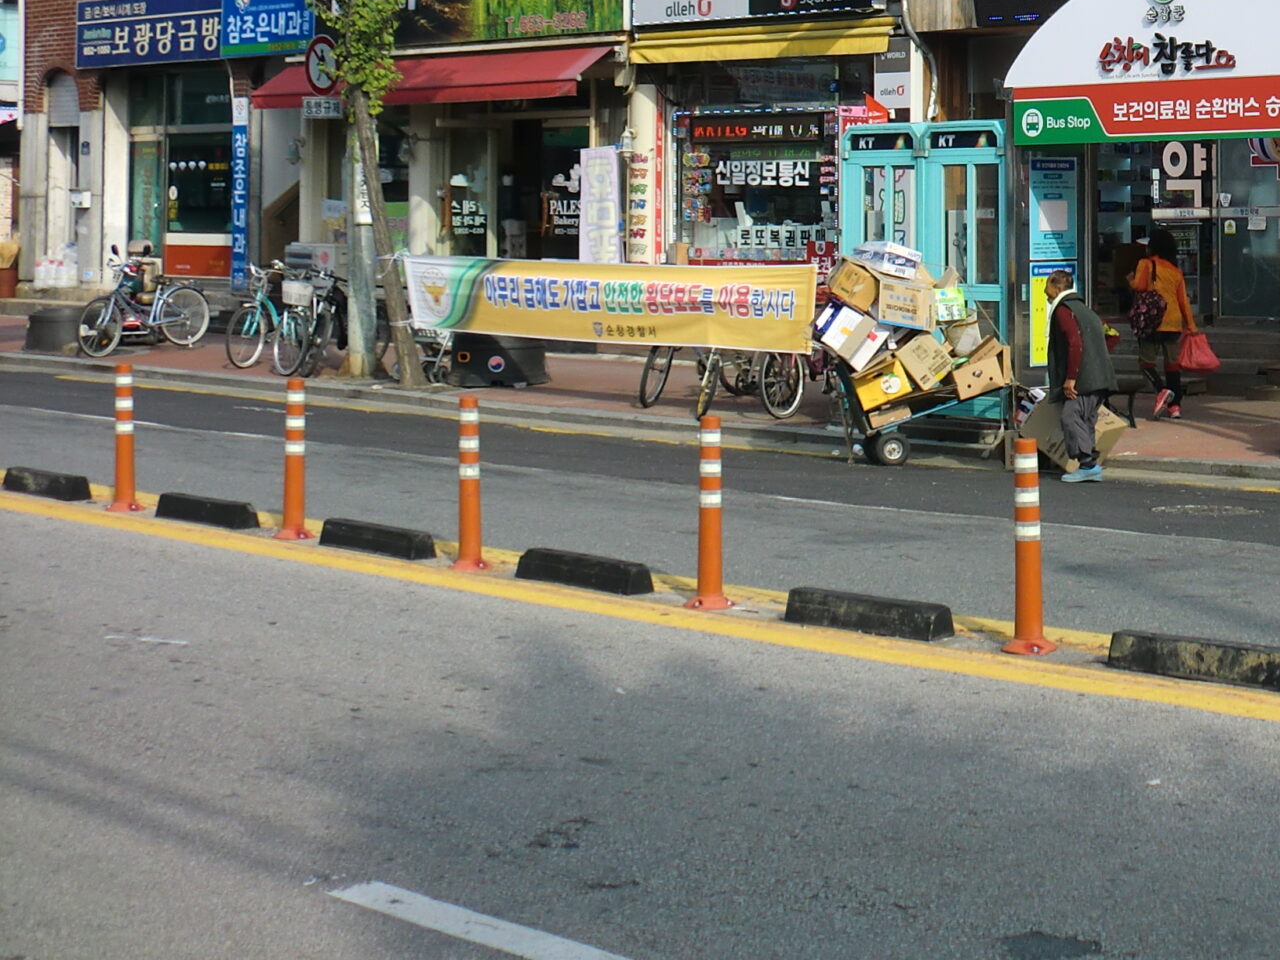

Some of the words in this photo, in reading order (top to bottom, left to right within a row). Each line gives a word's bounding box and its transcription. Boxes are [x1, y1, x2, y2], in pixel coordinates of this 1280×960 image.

[665, 0, 696, 18] olleh
[1144, 5, 1187, 23] 순창군
[227, 10, 302, 44] 참조은내과
[112, 17, 222, 56] 보광당금방
[887, 51, 906, 59] WORLD
[880, 87, 897, 96] olleh
[1112, 99, 1191, 122] 보건의료원
[1195, 97, 1260, 120] 순환버스
[1046, 115, 1064, 129] Bus
[1066, 115, 1091, 131] Stop
[858, 137, 875, 149] KT
[937, 134, 956, 148] KT
[714, 160, 811, 187] 신일정보통신
[1162, 141, 1207, 207] 약
[233, 133, 247, 253] 참조은내과
[553, 216, 579, 226] Bakery
[739, 226, 827, 247] 로또복권판매
[484, 275, 522, 308] 아무리
[523, 277, 561, 310] 급해도
[604, 281, 643, 314] 안전한
[646, 284, 714, 315] 횡단보도를
[717, 283, 796, 320] 이용합시다
[606, 324, 657, 338] 순창경찰서
